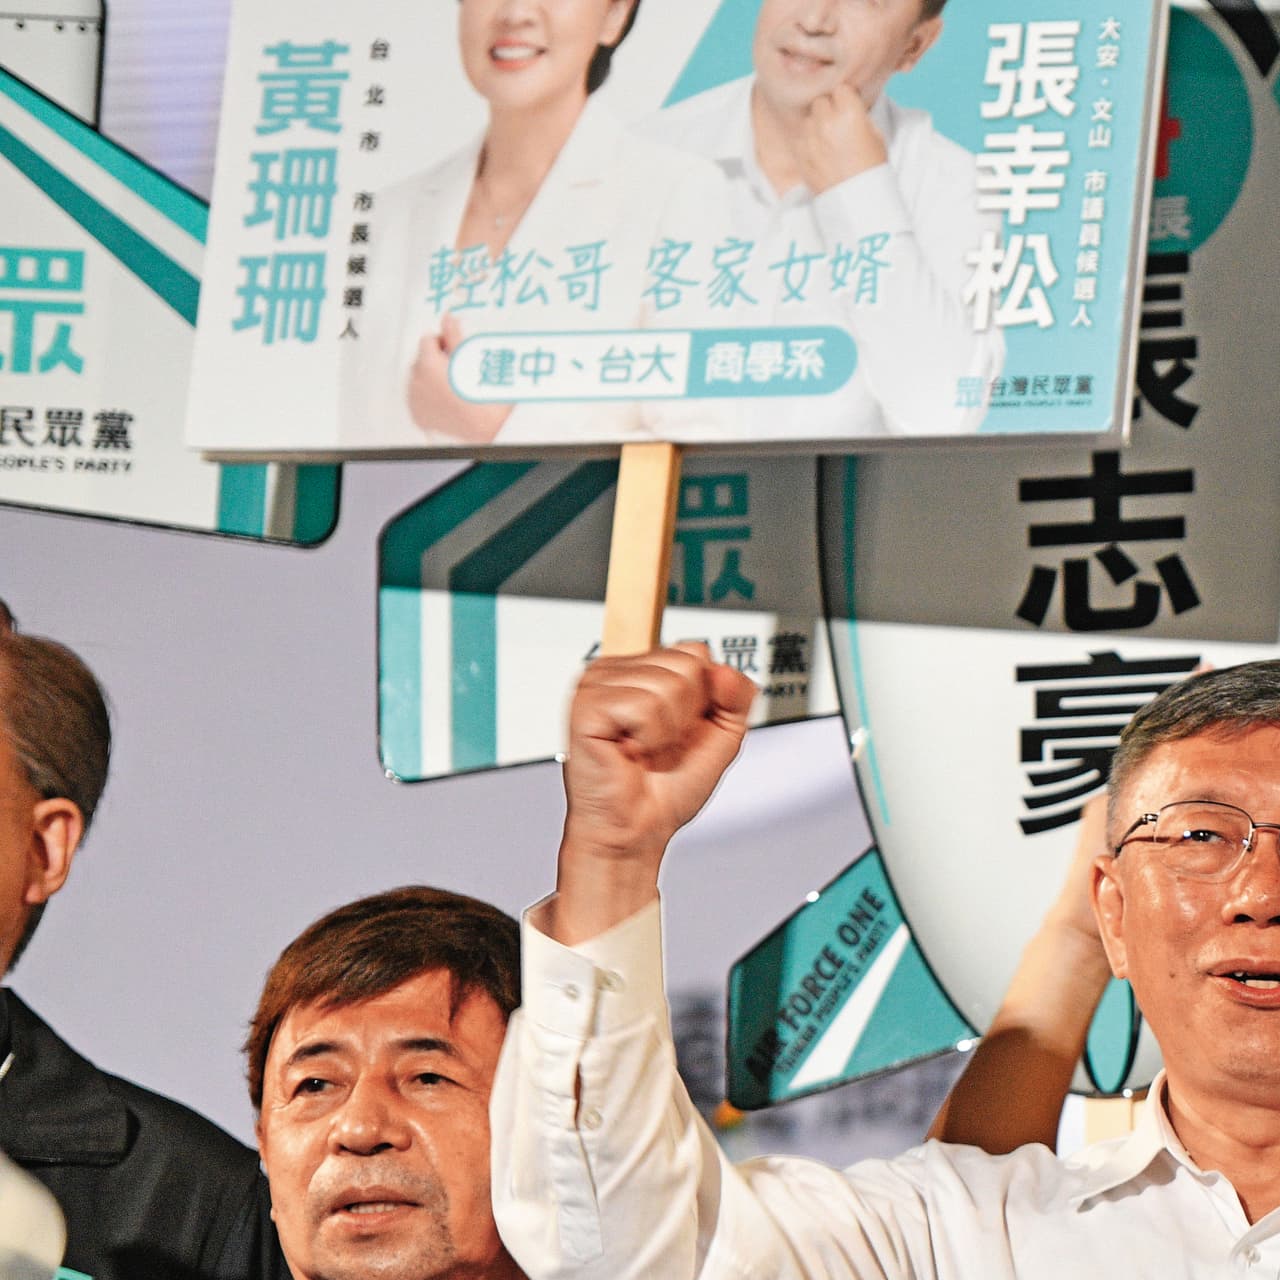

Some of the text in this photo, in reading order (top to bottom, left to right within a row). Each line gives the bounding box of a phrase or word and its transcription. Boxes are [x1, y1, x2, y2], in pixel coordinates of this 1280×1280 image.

[231, 39, 350, 345] 黃珊珊
[339, 38, 391, 341] 台北市 市長候選人
[963, 20, 1081, 333] 張幸松
[425, 231, 895, 317] 輕松哥 客家女婿
[1069, 170, 1108, 328] 市議員候選人
[704, 340, 826, 384] 商學系
[989, 375, 1095, 397] 台灣民眾黨
[0, 455, 132, 473] OPLE'S PARTY
[677, 632, 807, 675] 眾黨
[777, 945, 844, 1032] FORCE
[836, 885, 886, 947] ONE
